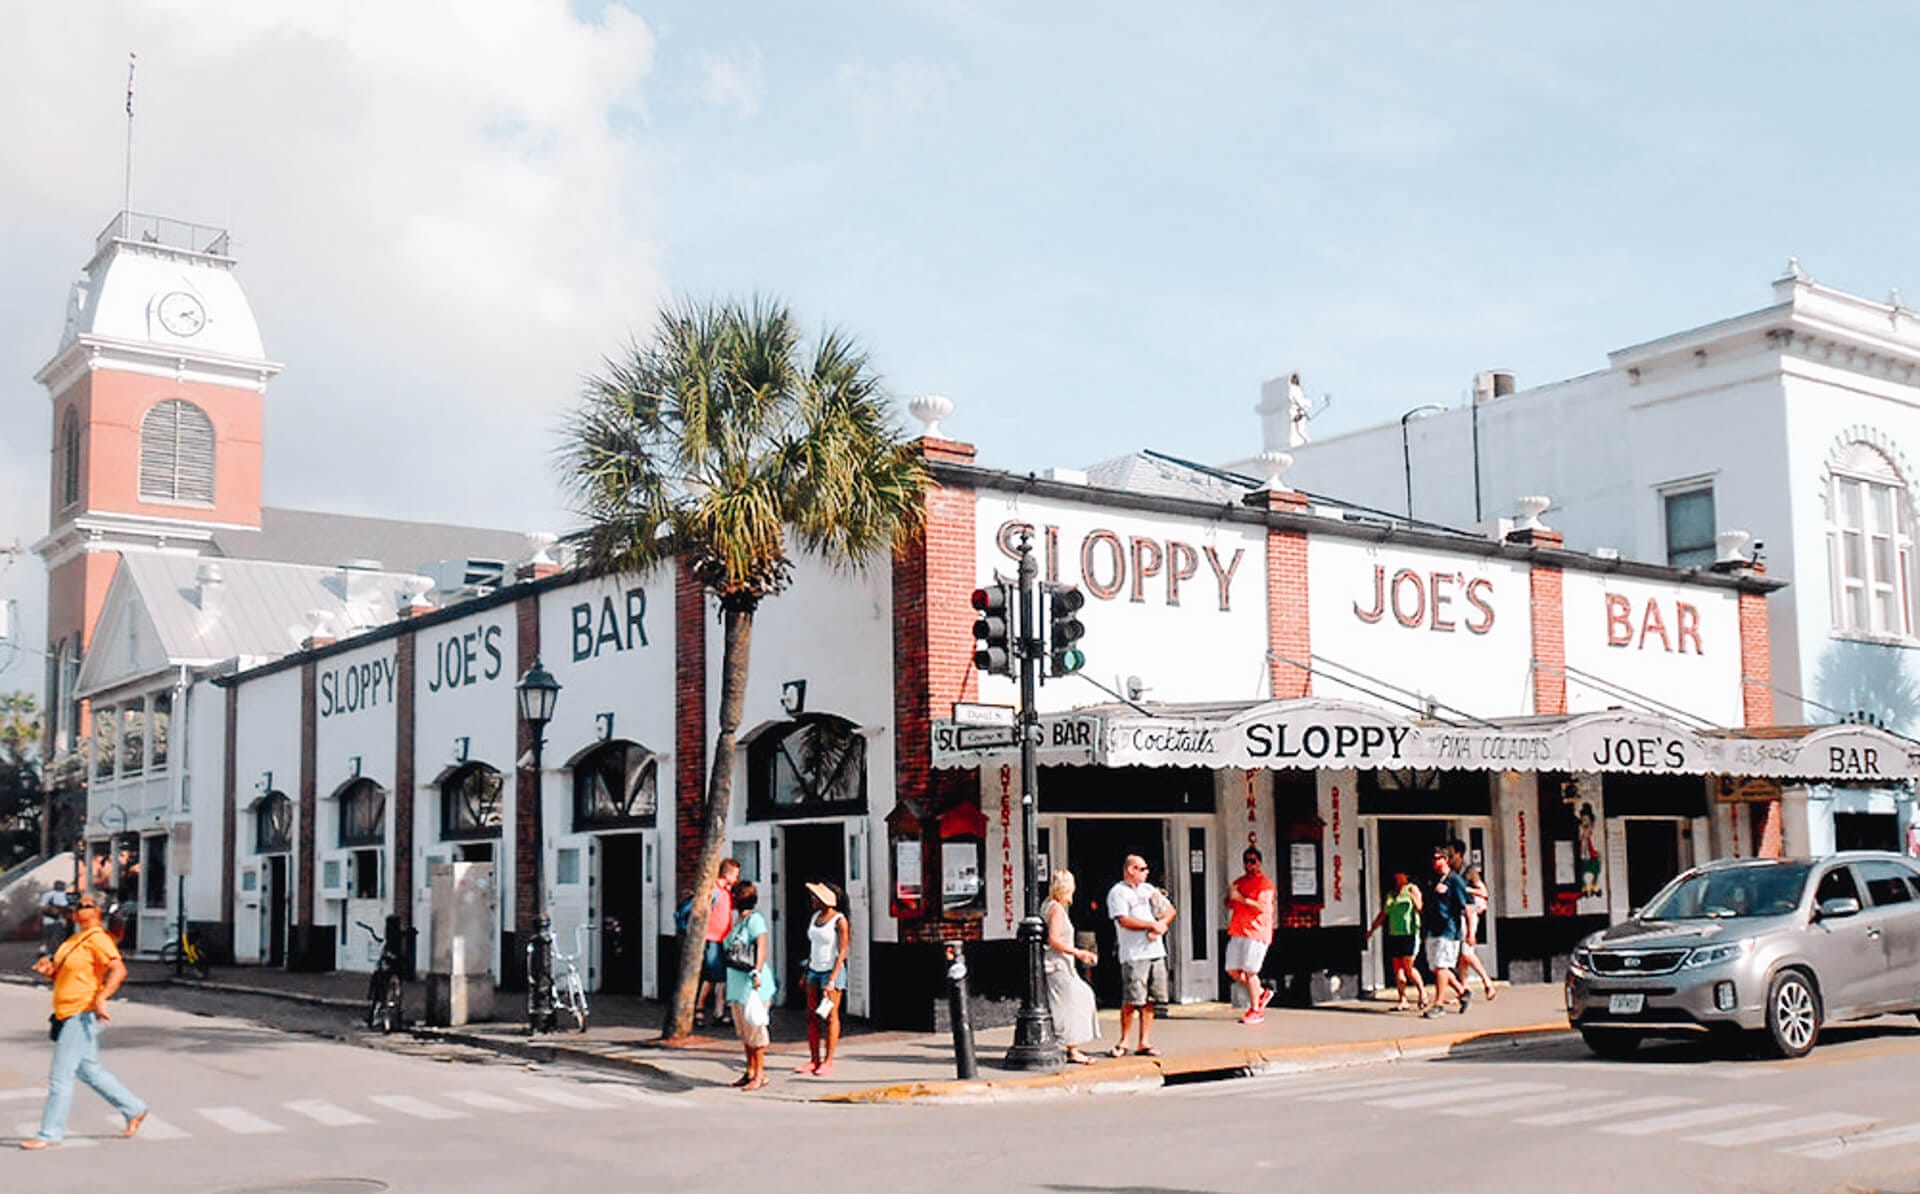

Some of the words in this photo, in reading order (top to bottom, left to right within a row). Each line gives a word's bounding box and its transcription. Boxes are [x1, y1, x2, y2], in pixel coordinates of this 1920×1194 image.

[994, 519, 1245, 612] SLOPPY
[1353, 564, 1495, 635] JOE'S
[1605, 592, 1703, 656] BAR
[321, 653, 398, 717] SLOPPY
[428, 625, 502, 693] JOE'S
[572, 587, 649, 662] BAR
[1053, 721, 1091, 746] BAR
[1133, 727, 1215, 753] Cocktails
[1246, 723, 1411, 759] SLOPPY
[1593, 736, 1685, 768] JOE'S
[1829, 746, 1880, 774] BAR
